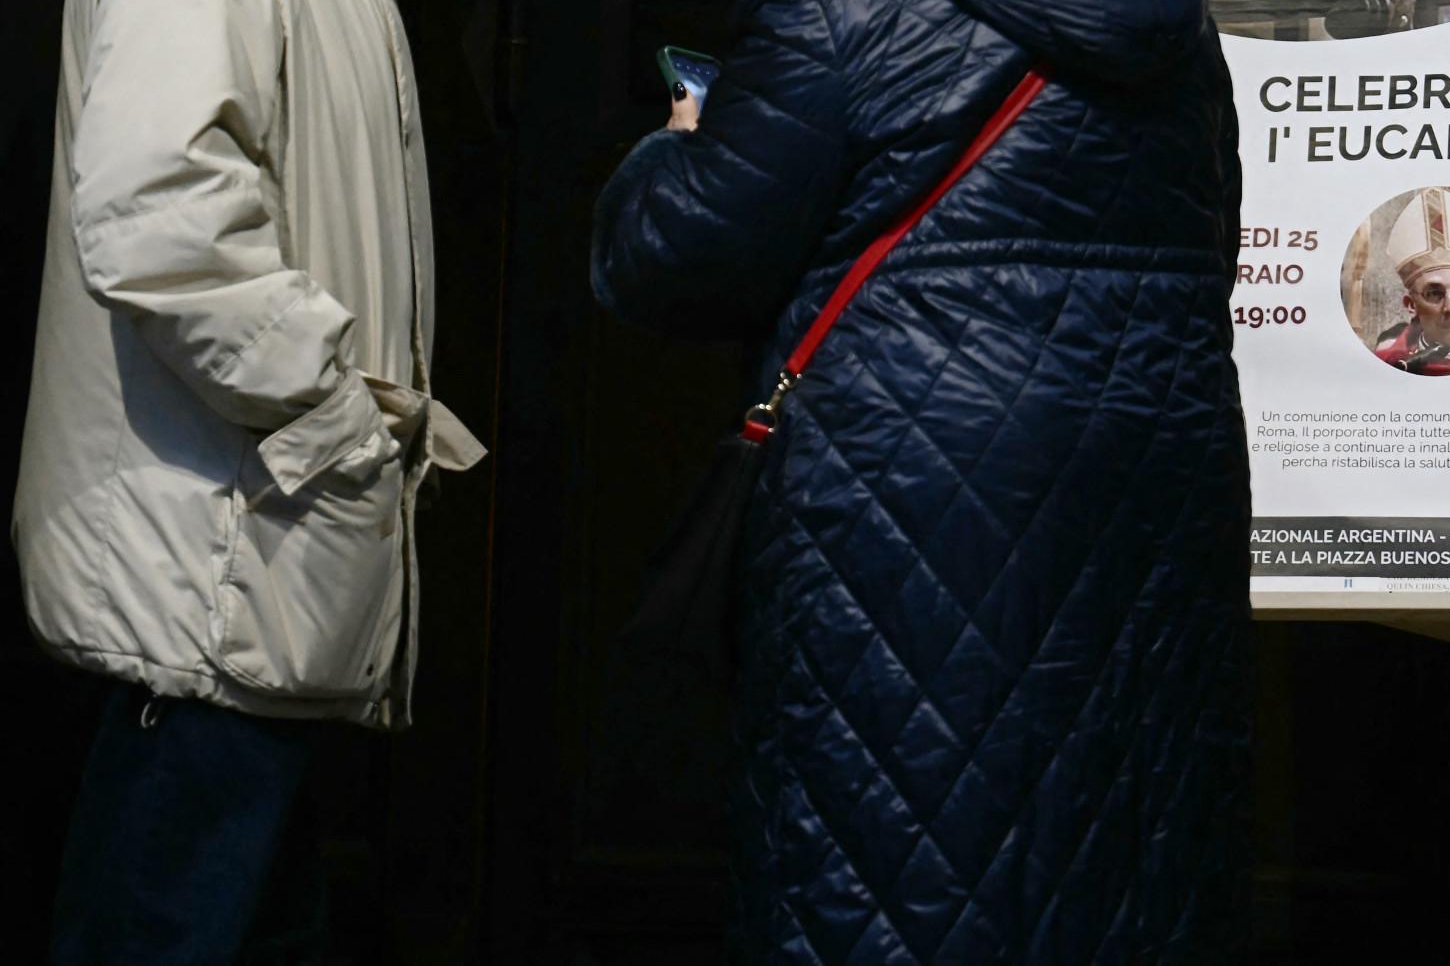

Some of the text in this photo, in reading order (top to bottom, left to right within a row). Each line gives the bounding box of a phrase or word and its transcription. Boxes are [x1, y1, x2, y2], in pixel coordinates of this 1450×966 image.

[1287, 230, 1319, 252] 25
[1233, 305, 1307, 329] 19:00
[1262, 411, 1280, 422] Un
[1283, 411, 1358, 423] comunione
[1361, 413, 1386, 423] con
[1390, 411, 1401, 423] la
[1312, 427, 1378, 439] porporato
[1382, 426, 1416, 438] invita
[1420, 427, 1450, 438] tutte
[1251, 443, 1260, 452] e
[1263, 440, 1320, 454] religiose
[1322, 443, 1331, 452] a
[1334, 441, 1405, 453] continuare
[1407, 444, 1416, 453] a
[1332, 456, 1400, 468] ristabilisca
[1404, 456, 1415, 468] la
[1250, 529, 1334, 543] AZIONALE
[1337, 529, 1435, 543] ARGENTINA
[1275, 551, 1287, 564] A
[1291, 551, 1313, 564] LA
[1317, 551, 1376, 565] PIAZZA
[1380, 551, 1450, 565] BUENOS
